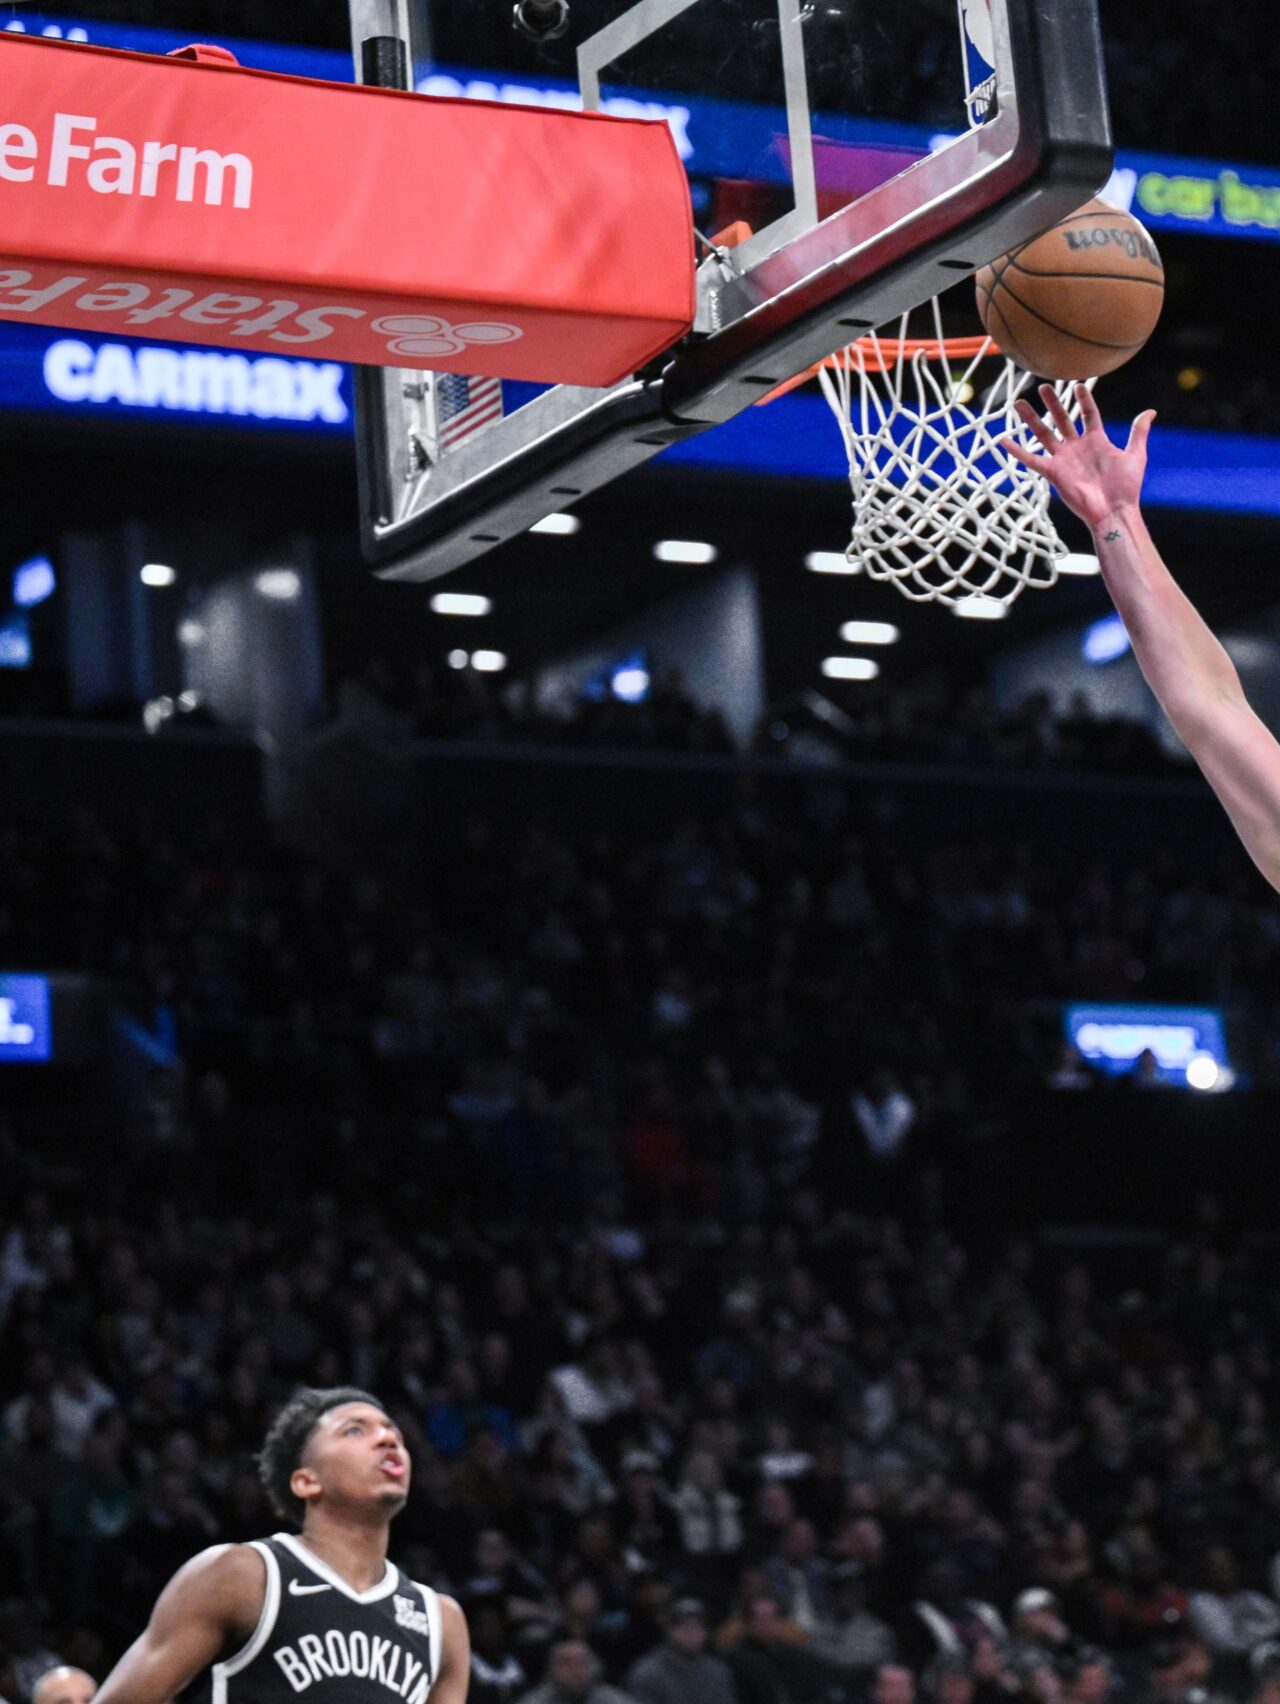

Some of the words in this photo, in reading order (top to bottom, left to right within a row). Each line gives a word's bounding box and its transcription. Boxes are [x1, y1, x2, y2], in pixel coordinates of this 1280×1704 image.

[48, 112, 253, 209] Farm
[1138, 173, 1214, 221] car
[76, 282, 368, 343] State
